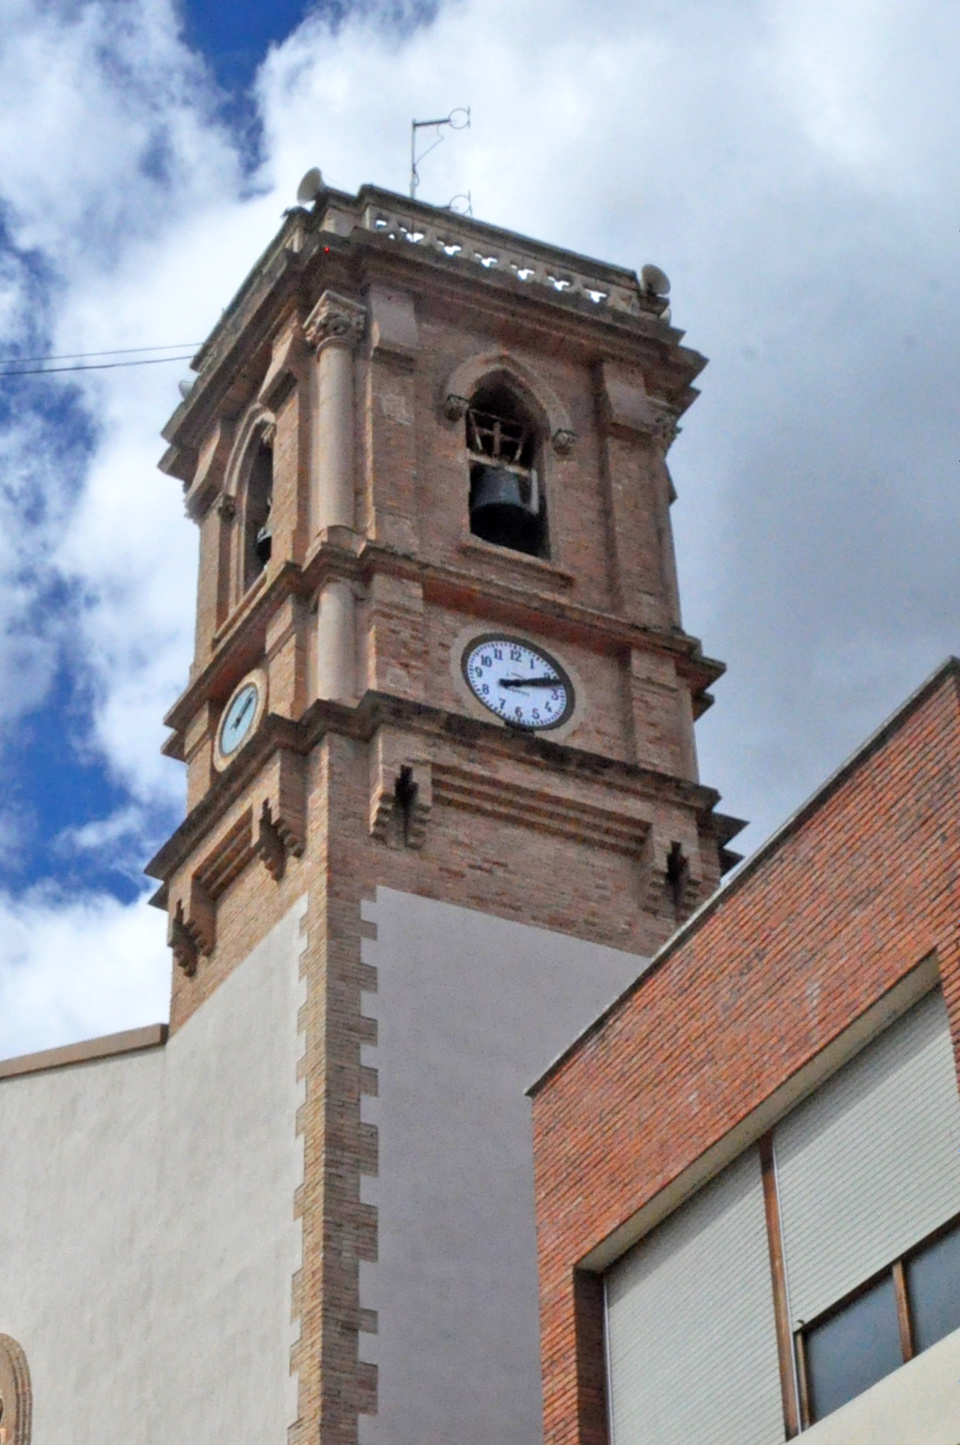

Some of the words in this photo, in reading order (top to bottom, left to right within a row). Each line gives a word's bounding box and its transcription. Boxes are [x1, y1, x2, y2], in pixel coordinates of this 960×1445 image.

[494, 648, 503, 661] 11
[510, 649, 522, 662] 12
[481, 655, 493, 667] 10
[529, 658, 536, 669] 1
[475, 666, 483, 678] 9
[482, 683, 490, 695] 8
[551, 688, 559, 701] 3
[498, 698, 507, 710] 7
[544, 701, 553, 713] 4
[515, 706, 523, 719] 6
[532, 707, 540, 720] 5
